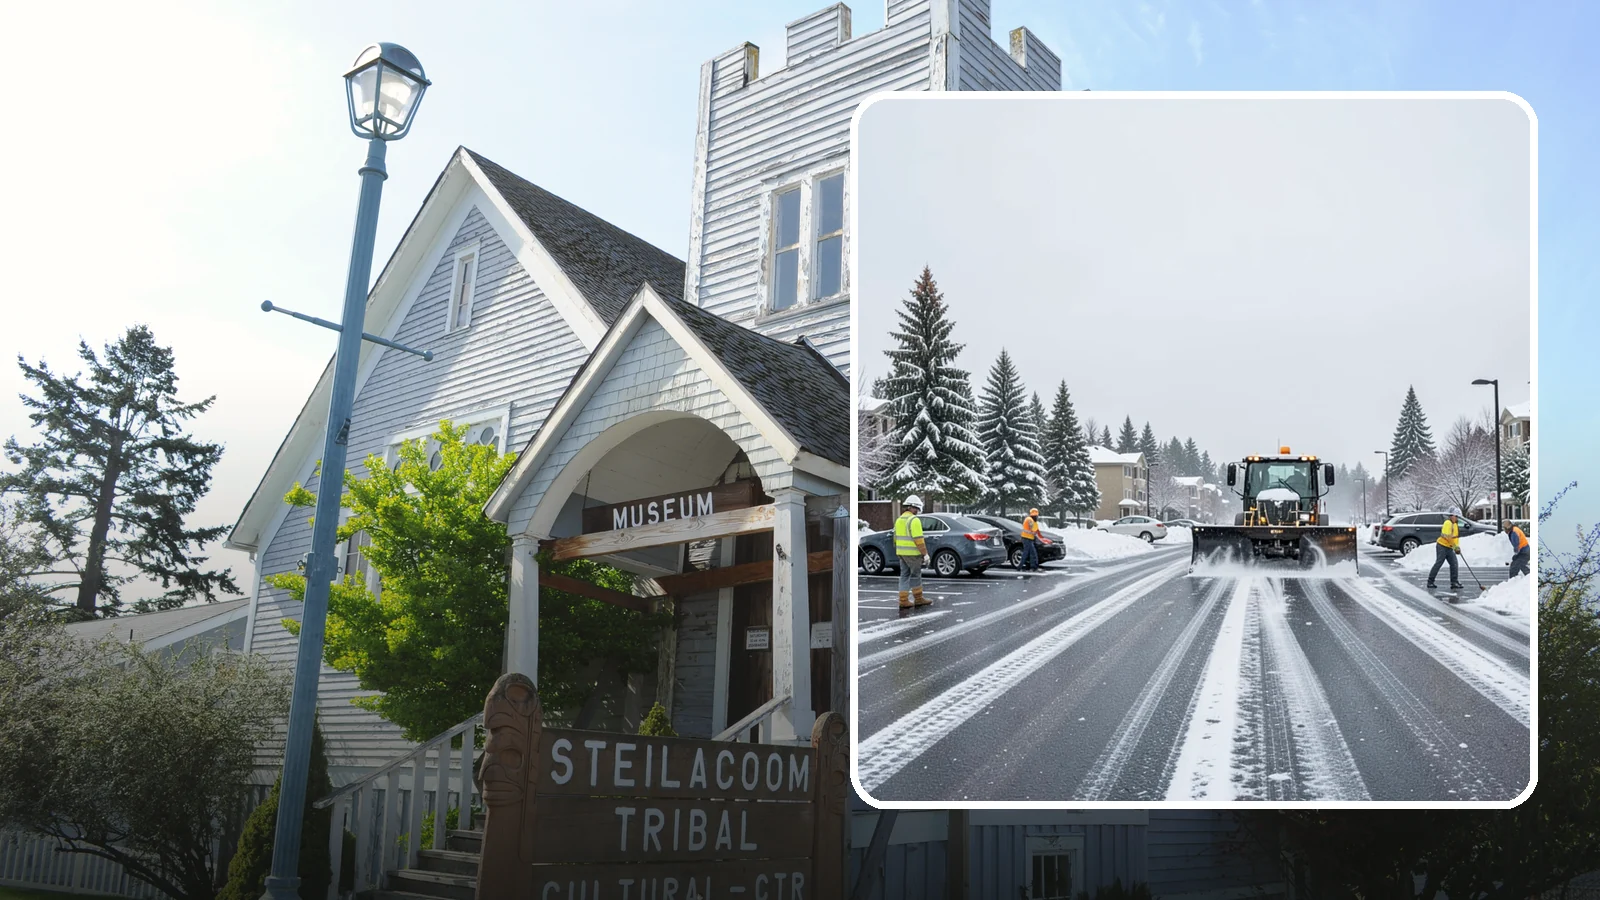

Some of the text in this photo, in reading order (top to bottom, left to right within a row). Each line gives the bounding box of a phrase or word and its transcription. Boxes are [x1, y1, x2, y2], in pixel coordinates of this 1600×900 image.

[612, 491, 714, 530] MUSEUM
[551, 738, 809, 792] STEILACOOM
[615, 807, 757, 852] TRIBAL
